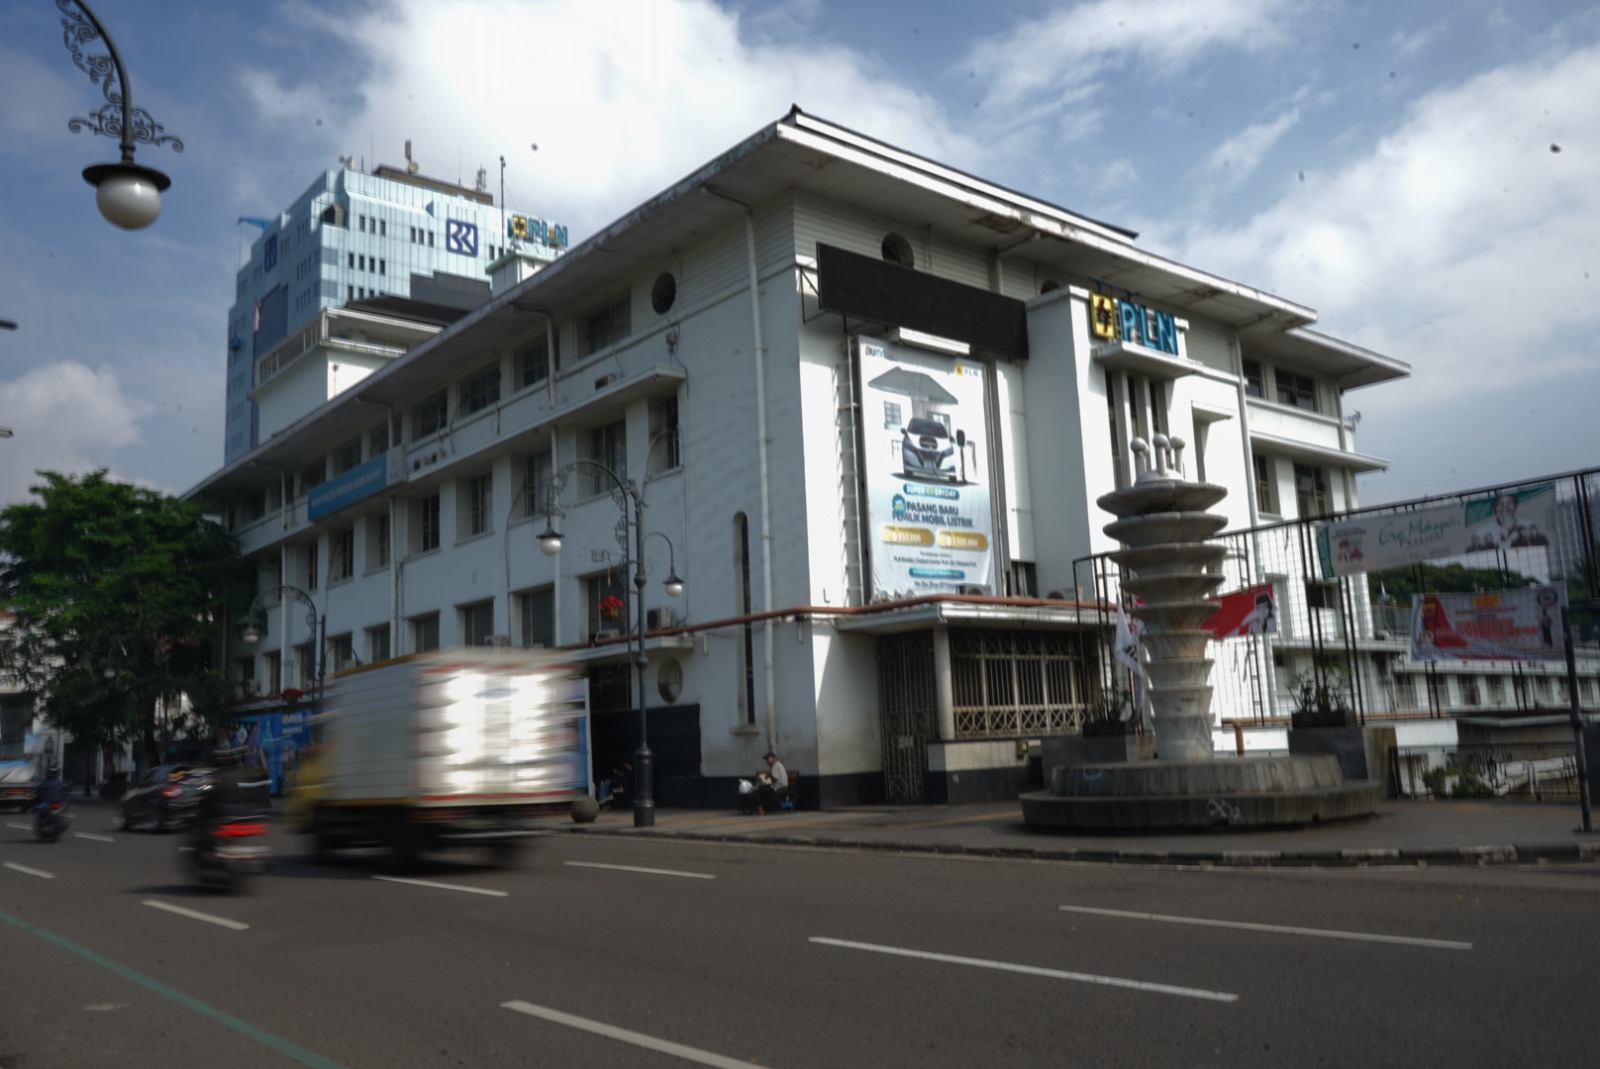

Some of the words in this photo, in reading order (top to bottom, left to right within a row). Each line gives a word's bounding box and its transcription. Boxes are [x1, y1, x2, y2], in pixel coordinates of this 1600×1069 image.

[1119, 300, 1179, 356] PLN
[906, 501, 938, 514] PASANG
[938, 504, 959, 516] BARU
[921, 514, 946, 526] MOBIL
[946, 517, 974, 528] LISTRIK
